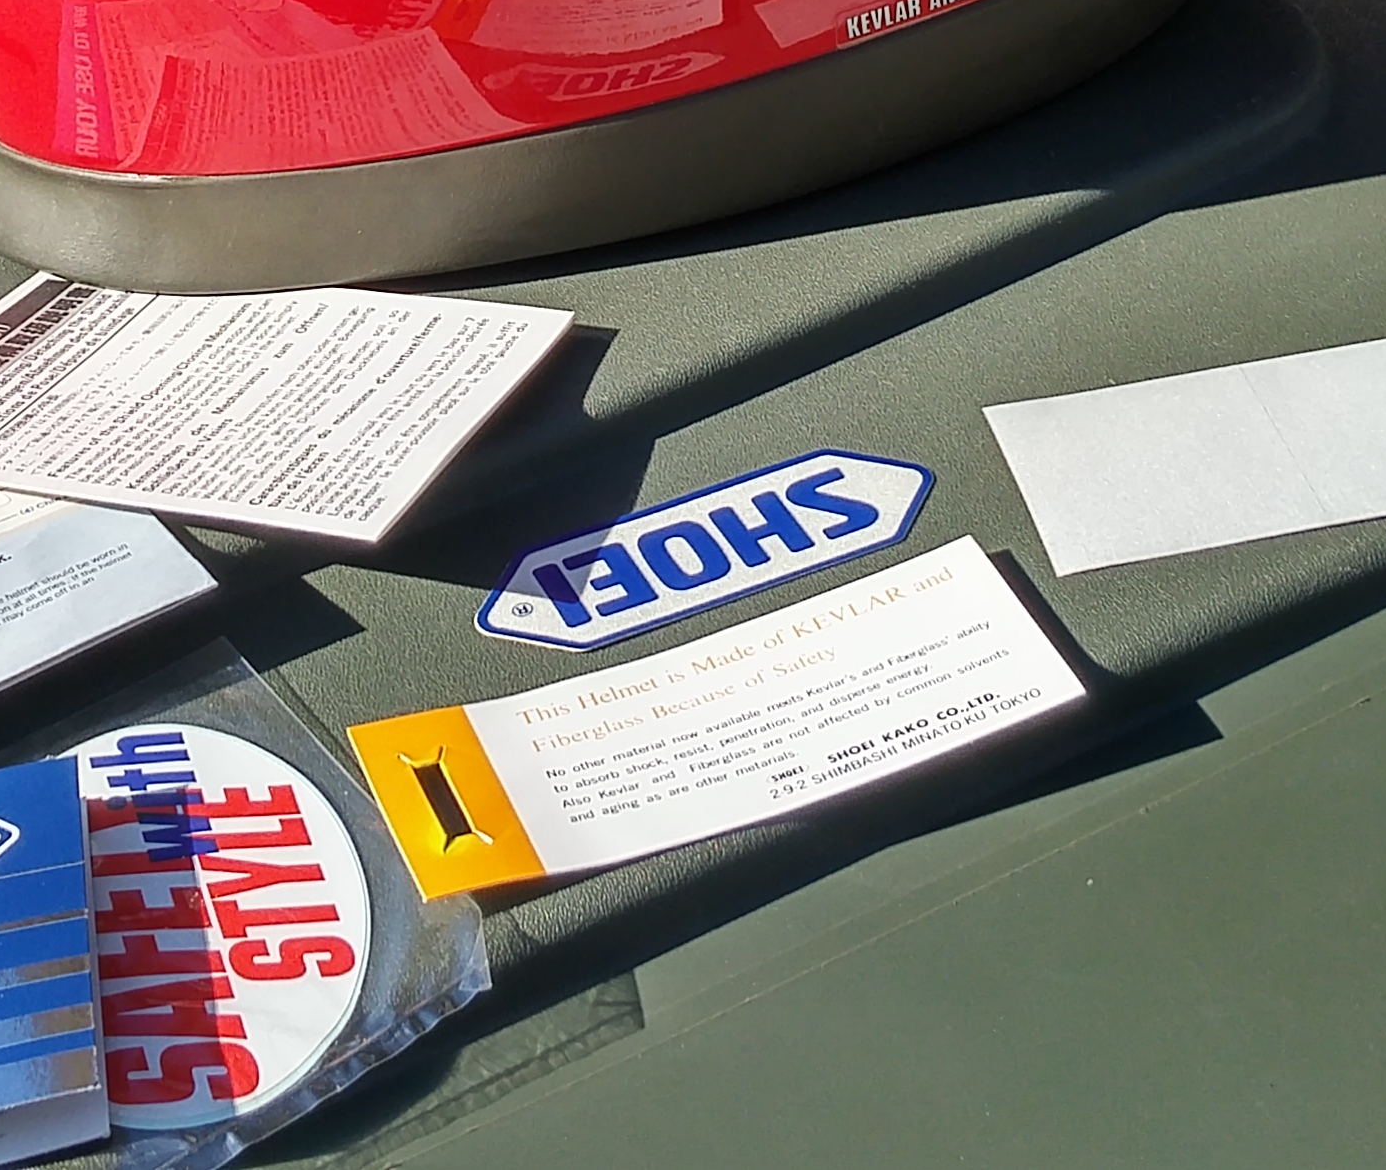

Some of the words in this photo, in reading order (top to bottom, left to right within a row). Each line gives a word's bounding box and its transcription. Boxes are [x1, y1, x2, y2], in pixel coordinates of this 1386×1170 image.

[67, 316, 88, 328] the
[79, 293, 113, 316] Shield
[79, 291, 138, 333] Schutzschil
[4, 581, 40, 602] helmet
[40, 566, 76, 585] should
[90, 549, 117, 564] worn
[533, 467, 879, 628] SHOEI
[515, 702, 571, 725] This
[577, 678, 659, 710] Helmet
[665, 670, 685, 684] is
[691, 645, 755, 675] Made
[763, 628, 784, 649] of
[791, 587, 906, 639] KEVLAR
[913, 566, 953, 592] and
[531, 716, 644, 753] Fiberglass
[651, 685, 735, 720] Because
[744, 669, 765, 688] of
[772, 649, 835, 678] Safety
[545, 768, 567, 780] No
[572, 757, 605, 773] other
[612, 739, 667, 762] material
[671, 731, 699, 744] now
[705, 710, 761, 734] available
[766, 695, 804, 713] meets
[805, 674, 857, 698] Kevlar's
[862, 662, 885, 677] and
[886, 635, 949, 667] Fiberglass'
[957, 620, 990, 640] ability
[553, 785, 569, 794] to
[575, 770, 620, 789] absorb
[625, 757, 669, 775] shock,
[673, 743, 715, 761] resist,
[718, 716, 796, 748] penetration,
[800, 702, 825, 718] and
[829, 683, 881, 707] disperse
[886, 664, 929, 685] energy.
[562, 796, 592, 809] Also
[597, 782, 640, 800] Kevlar
[651, 769, 676, 784] and
[688, 747, 757, 773] Fiberglass
[762, 737, 784, 750] are
[788, 726, 811, 740] not
[817, 703, 870, 730] affected
[873, 696, 891, 707] by
[896, 673, 952, 698] common
[957, 649, 1010, 675] solvents
[811, 745, 898, 785] SHIMBASHI
[989, 688, 1041, 714] TOKYO
[827, 739, 875, 764] SHOEI
[881, 718, 929, 743] KAKO
[90, 732, 220, 863] with
[569, 809, 596, 823] and
[601, 799, 641, 816] aging
[646, 793, 662, 803] as
[668, 785, 690, 797] are
[695, 773, 728, 788] other
[770, 765, 804, 783] SHOEI
[186, 784, 356, 981] STYLE
